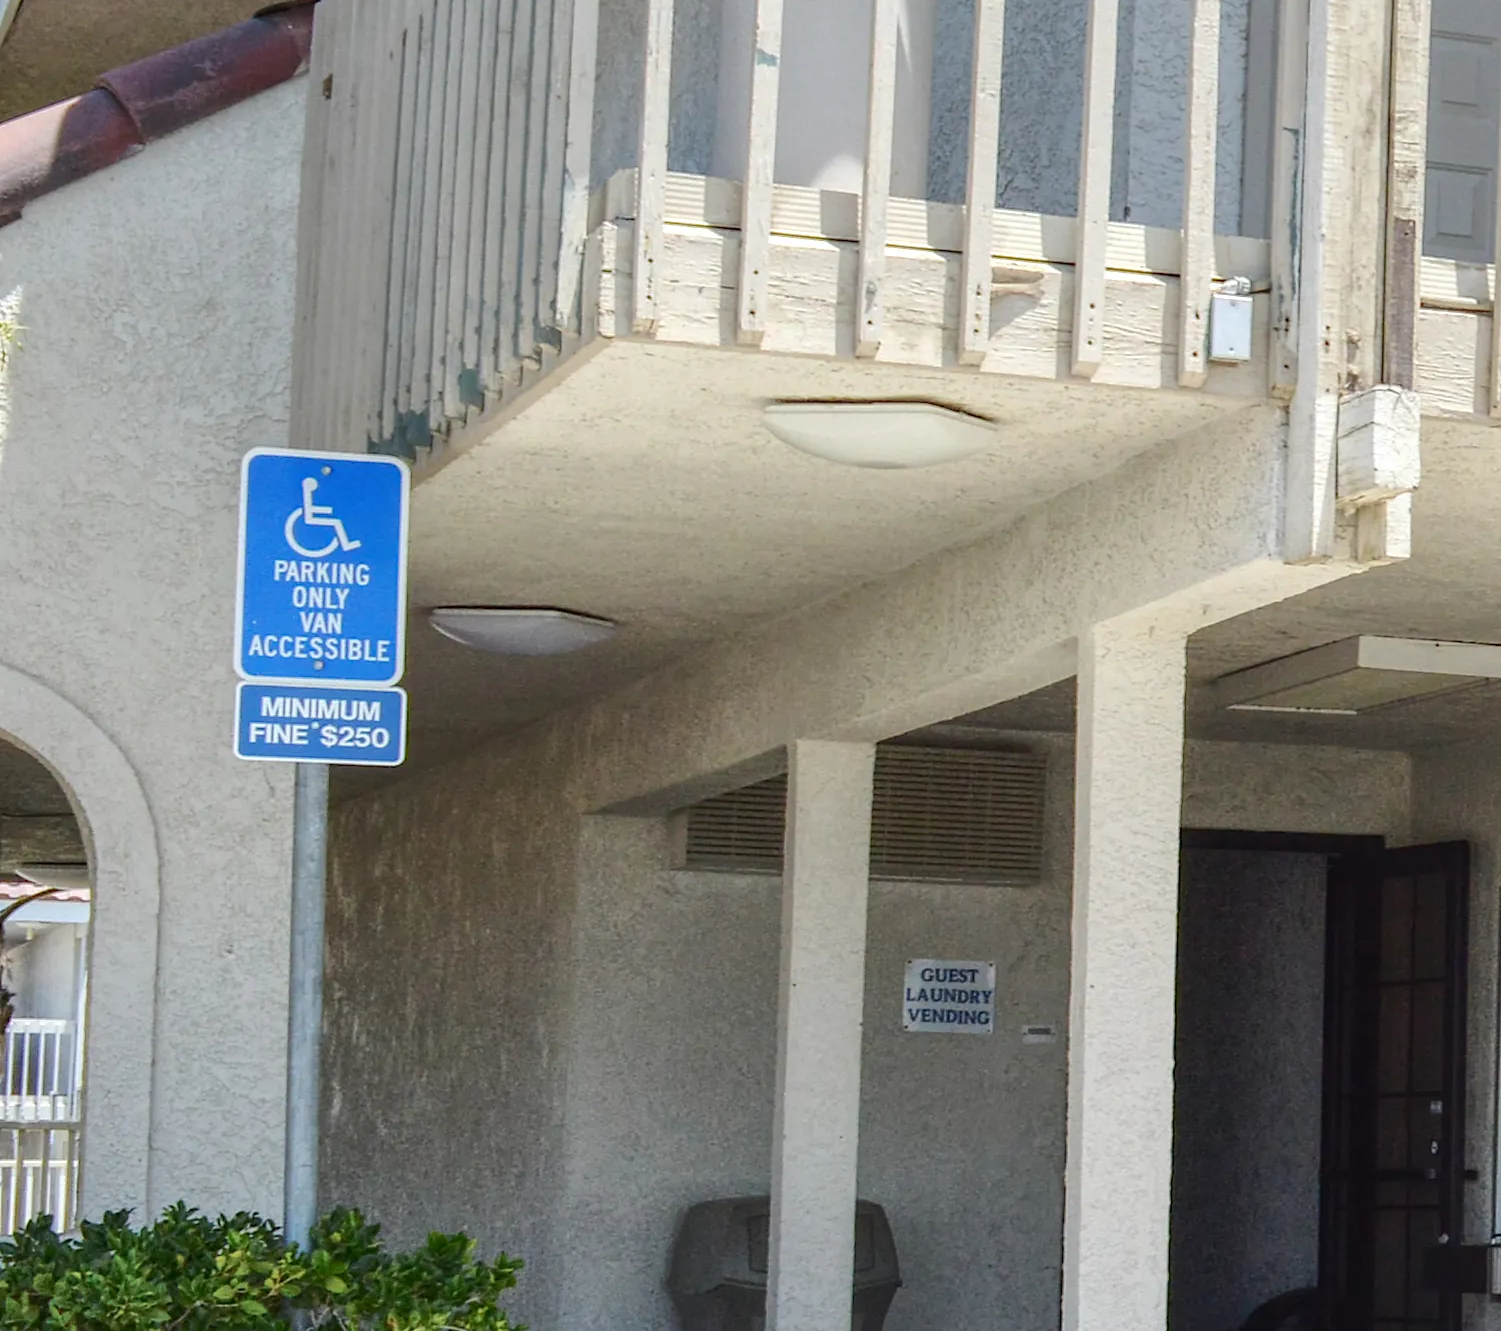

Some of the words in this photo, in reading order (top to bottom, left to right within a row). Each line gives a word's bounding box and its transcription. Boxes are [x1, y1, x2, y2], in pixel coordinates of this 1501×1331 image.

[273, 560, 370, 586] PARKING
[291, 587, 350, 611] ONLY
[299, 612, 343, 635] VAN
[248, 635, 391, 663] ACCESSIBLE
[261, 696, 381, 722] MINIMUM
[248, 724, 309, 746] FINE
[320, 725, 390, 749] $250
[920, 967, 980, 984] GUEST
[906, 987, 993, 1004] LAUNDRY
[907, 1008, 990, 1025] VENDING
